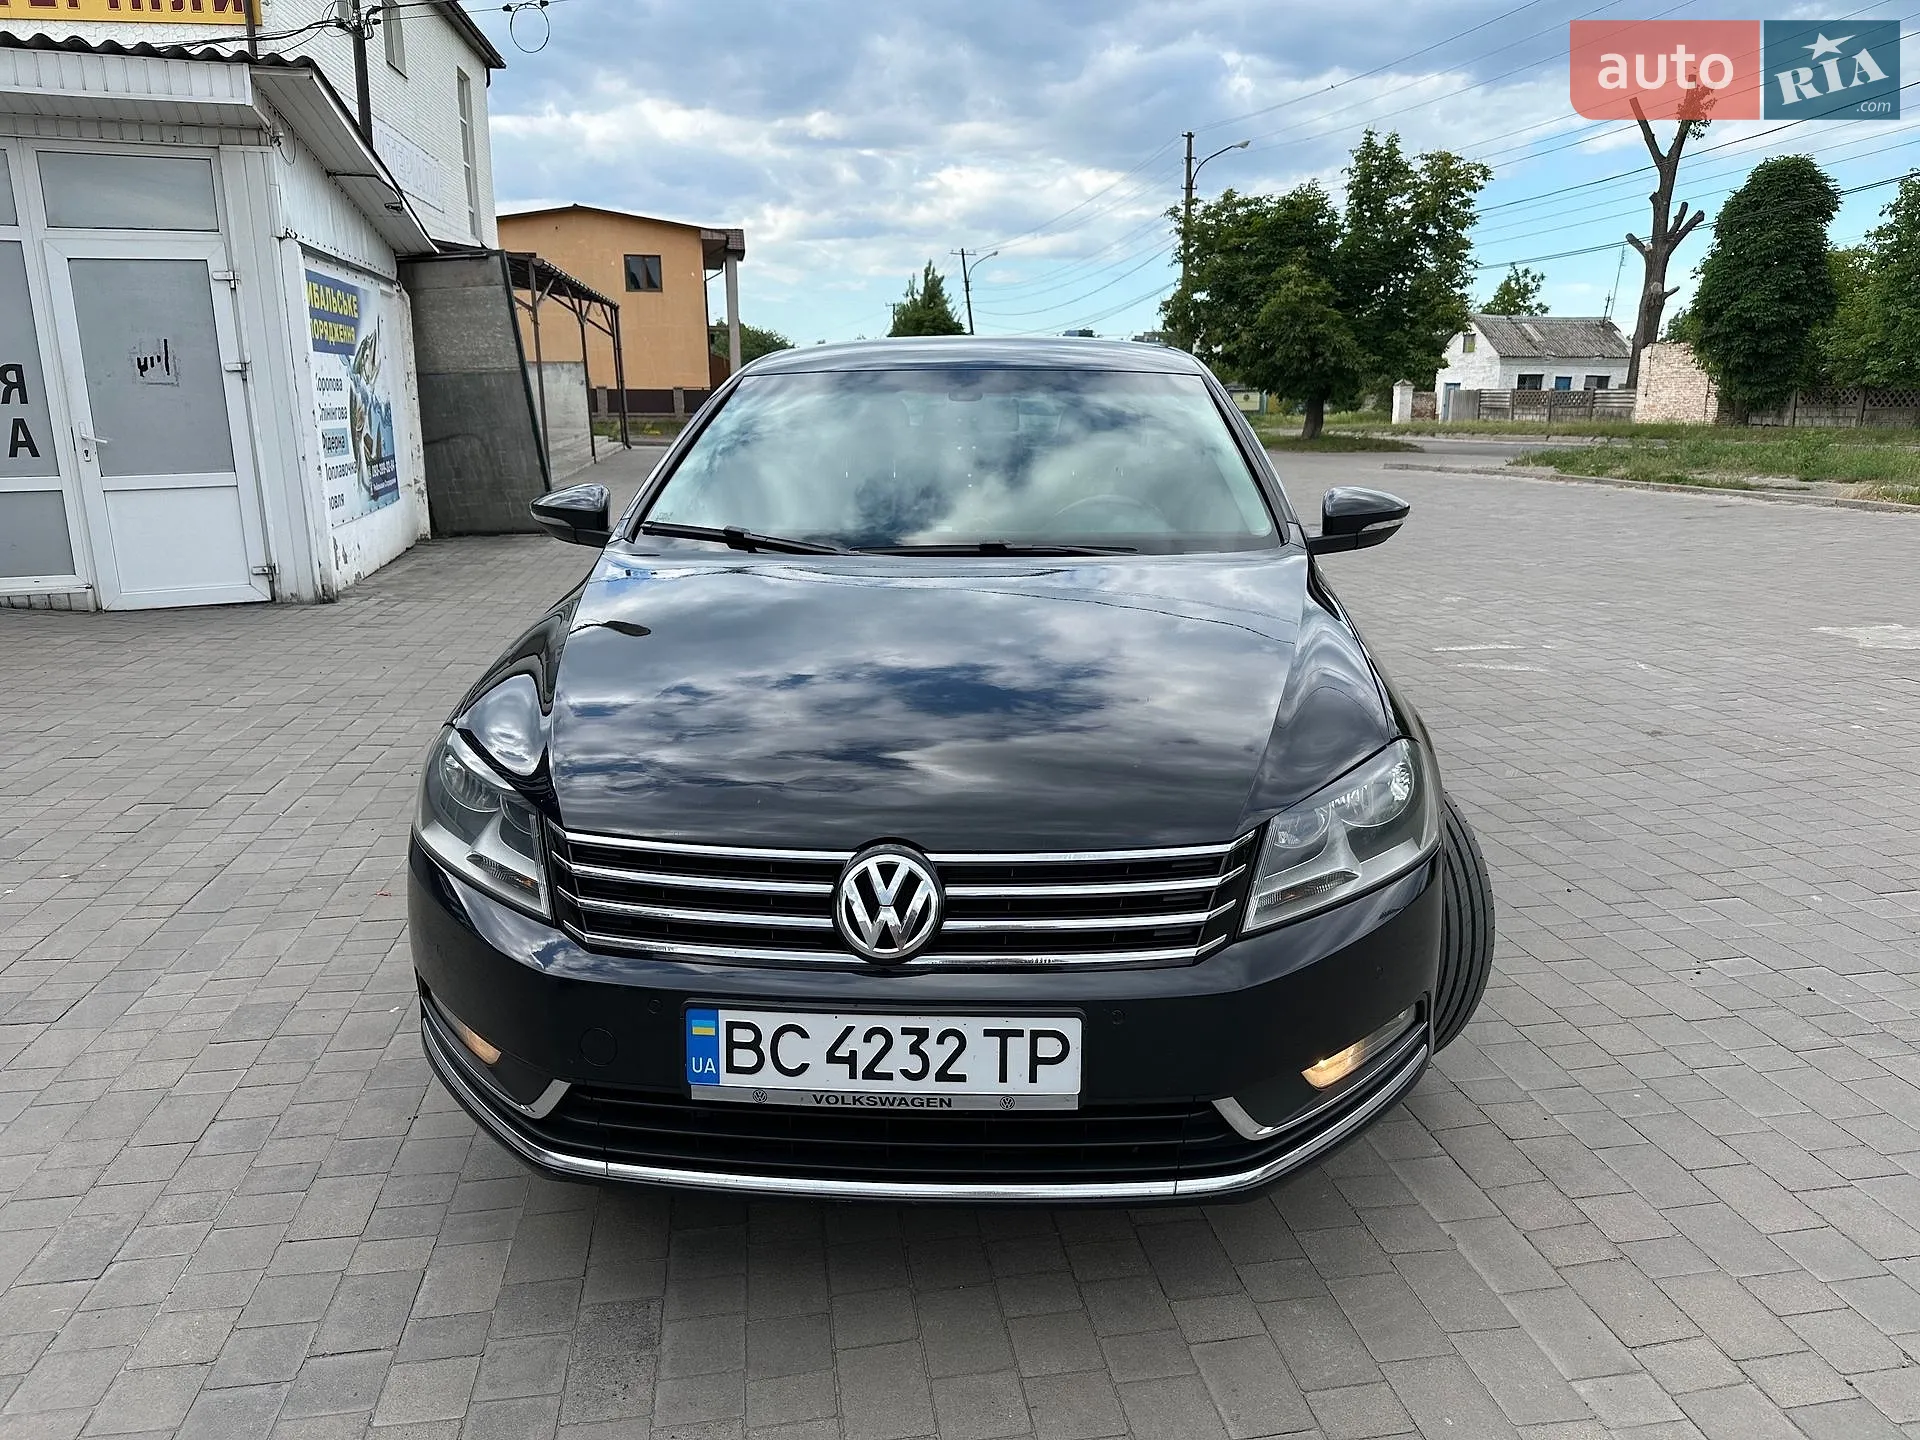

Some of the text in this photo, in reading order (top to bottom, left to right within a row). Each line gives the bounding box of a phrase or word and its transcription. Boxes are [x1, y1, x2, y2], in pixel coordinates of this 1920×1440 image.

[725, 1020, 1071, 1084] BC 4232 TP
[691, 1056, 717, 1074] UA
[812, 1093, 953, 1109] VOLKSWAGEN
